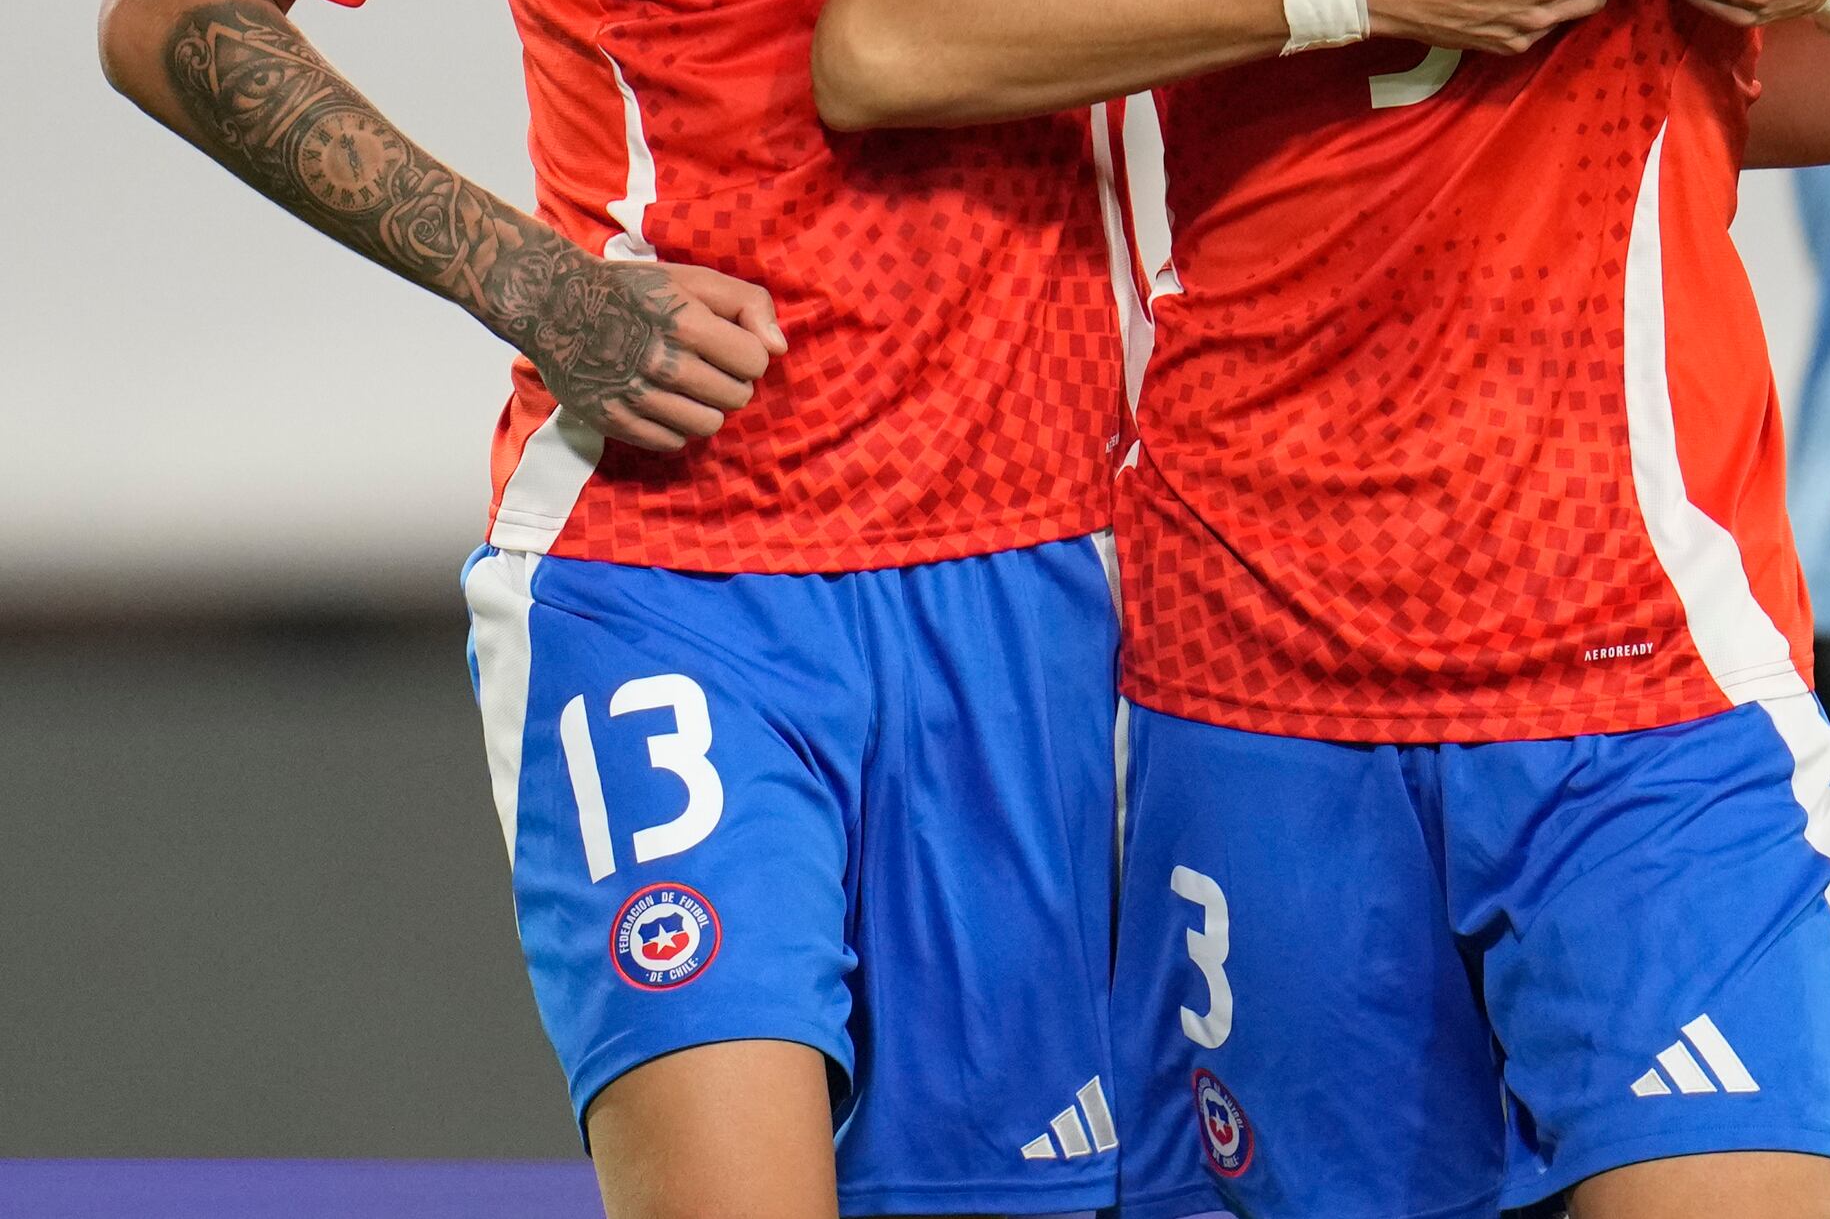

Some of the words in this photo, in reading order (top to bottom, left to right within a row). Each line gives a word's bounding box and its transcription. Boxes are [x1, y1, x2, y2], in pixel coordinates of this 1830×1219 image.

[1584, 642, 1654, 662] AEROREADY
[559, 673, 725, 885] 13
[618, 894, 655, 955] FEDERACION
[661, 891, 675, 903] DE
[679, 895, 710, 929] FUTBOL
[649, 971, 663, 983] DE
[669, 957, 698, 980] CHILE
[1170, 864, 1234, 1050] 3
